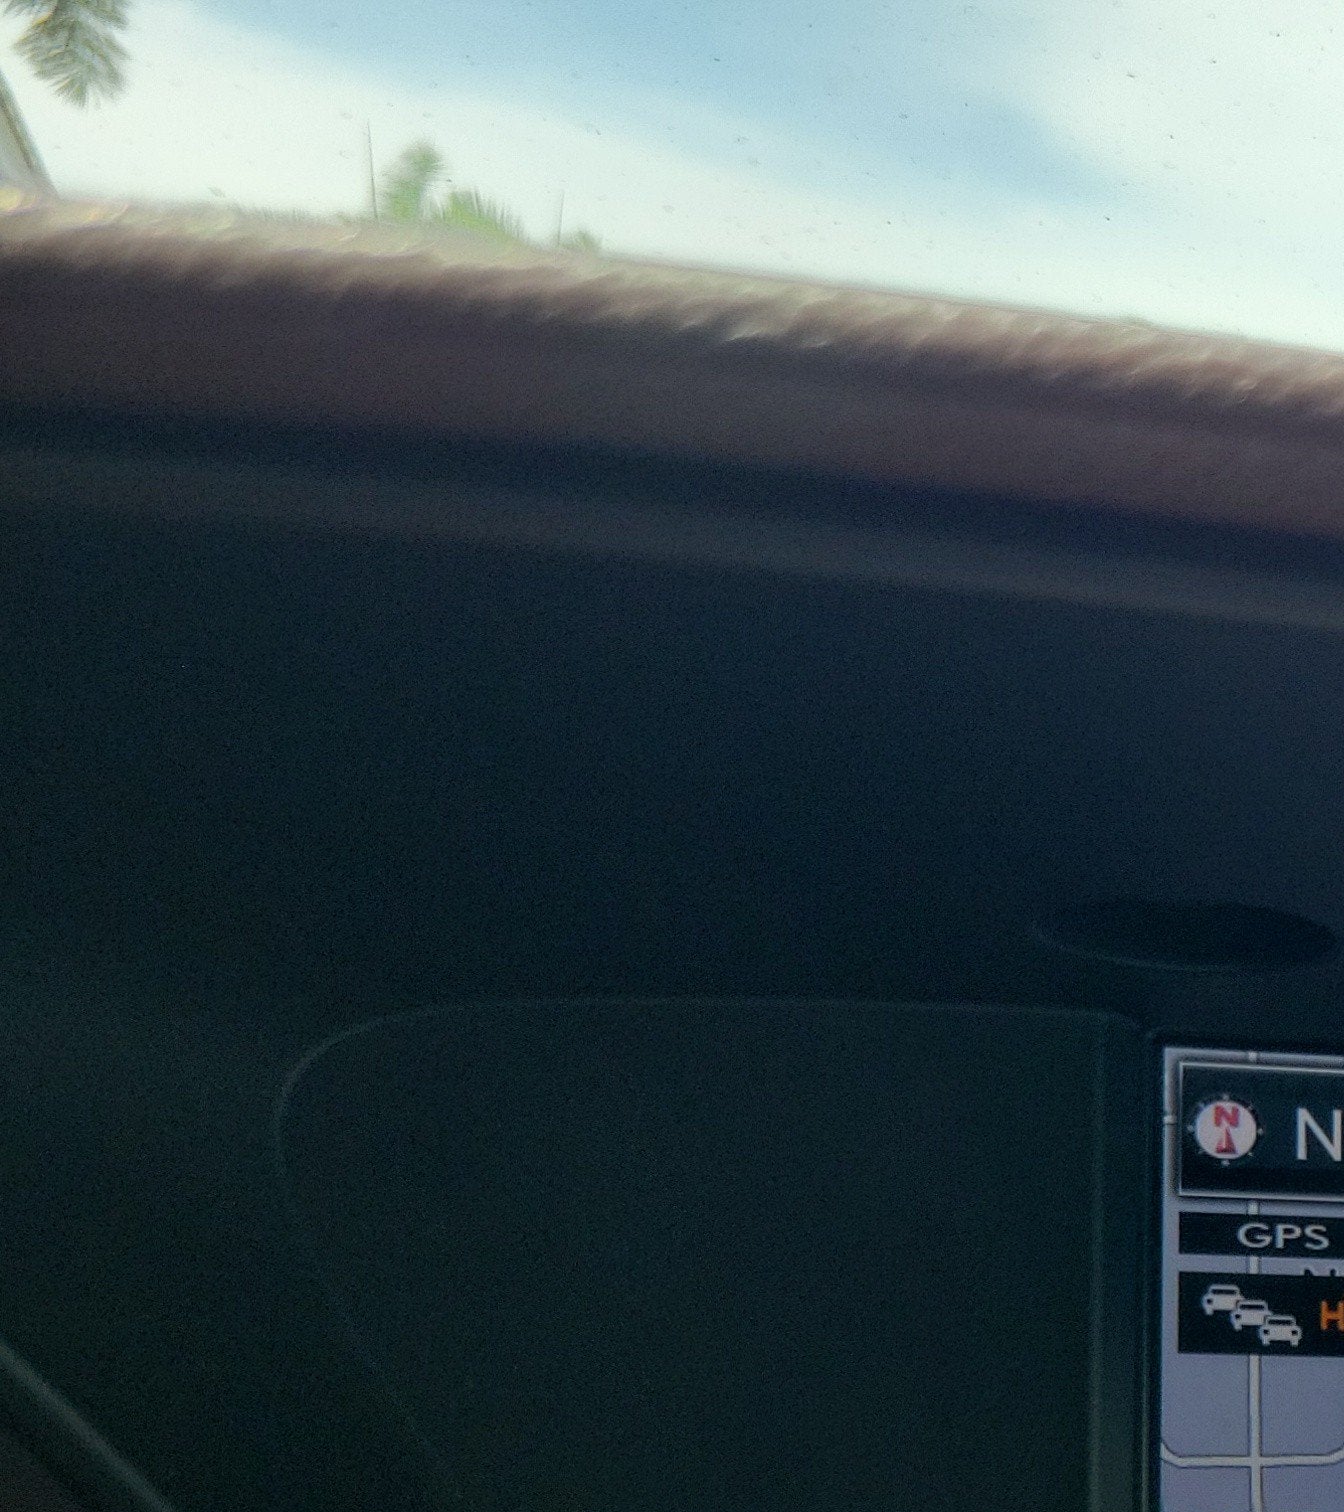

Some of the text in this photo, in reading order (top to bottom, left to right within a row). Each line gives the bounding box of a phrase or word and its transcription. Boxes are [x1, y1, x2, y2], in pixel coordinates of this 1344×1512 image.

[1213, 1105, 1240, 1128] N
[1297, 1108, 1343, 1161] N
[1238, 1223, 1330, 1250] GPS
